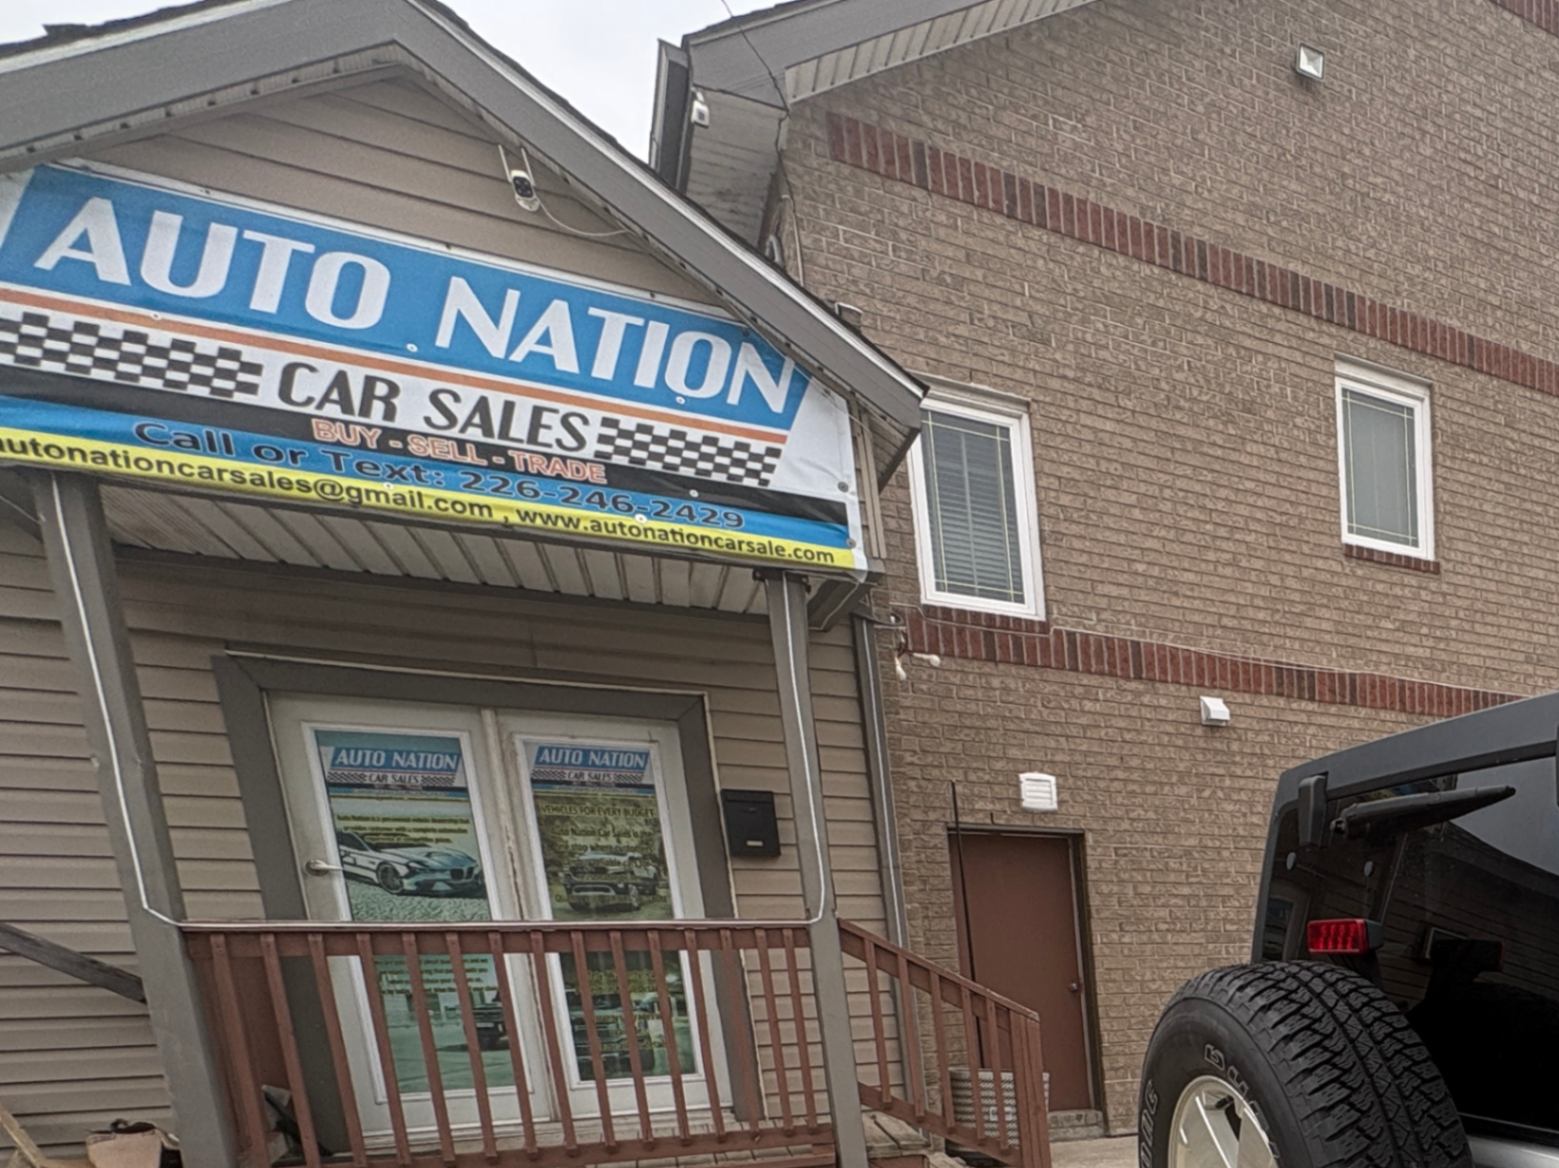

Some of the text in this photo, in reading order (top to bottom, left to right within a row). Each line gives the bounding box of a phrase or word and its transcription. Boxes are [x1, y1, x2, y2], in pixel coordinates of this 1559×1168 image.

[33, 197, 796, 414] AUTO NATION
[277, 361, 591, 453] CAR SALES
[133, 421, 745, 530] Call or Text: 226-246-2429
[310, 418, 383, 449] BUY
[407, 433, 488, 466] SELL
[509, 450, 608, 484] TRADE
[516, 508, 835, 565] www.autonationcarsale.com
[335, 749, 459, 770] AUTO NATION
[367, 773, 421, 785] CAR SALES
[539, 748, 647, 768] AUTO NATION
[567, 770, 614, 781] CAR SALES
